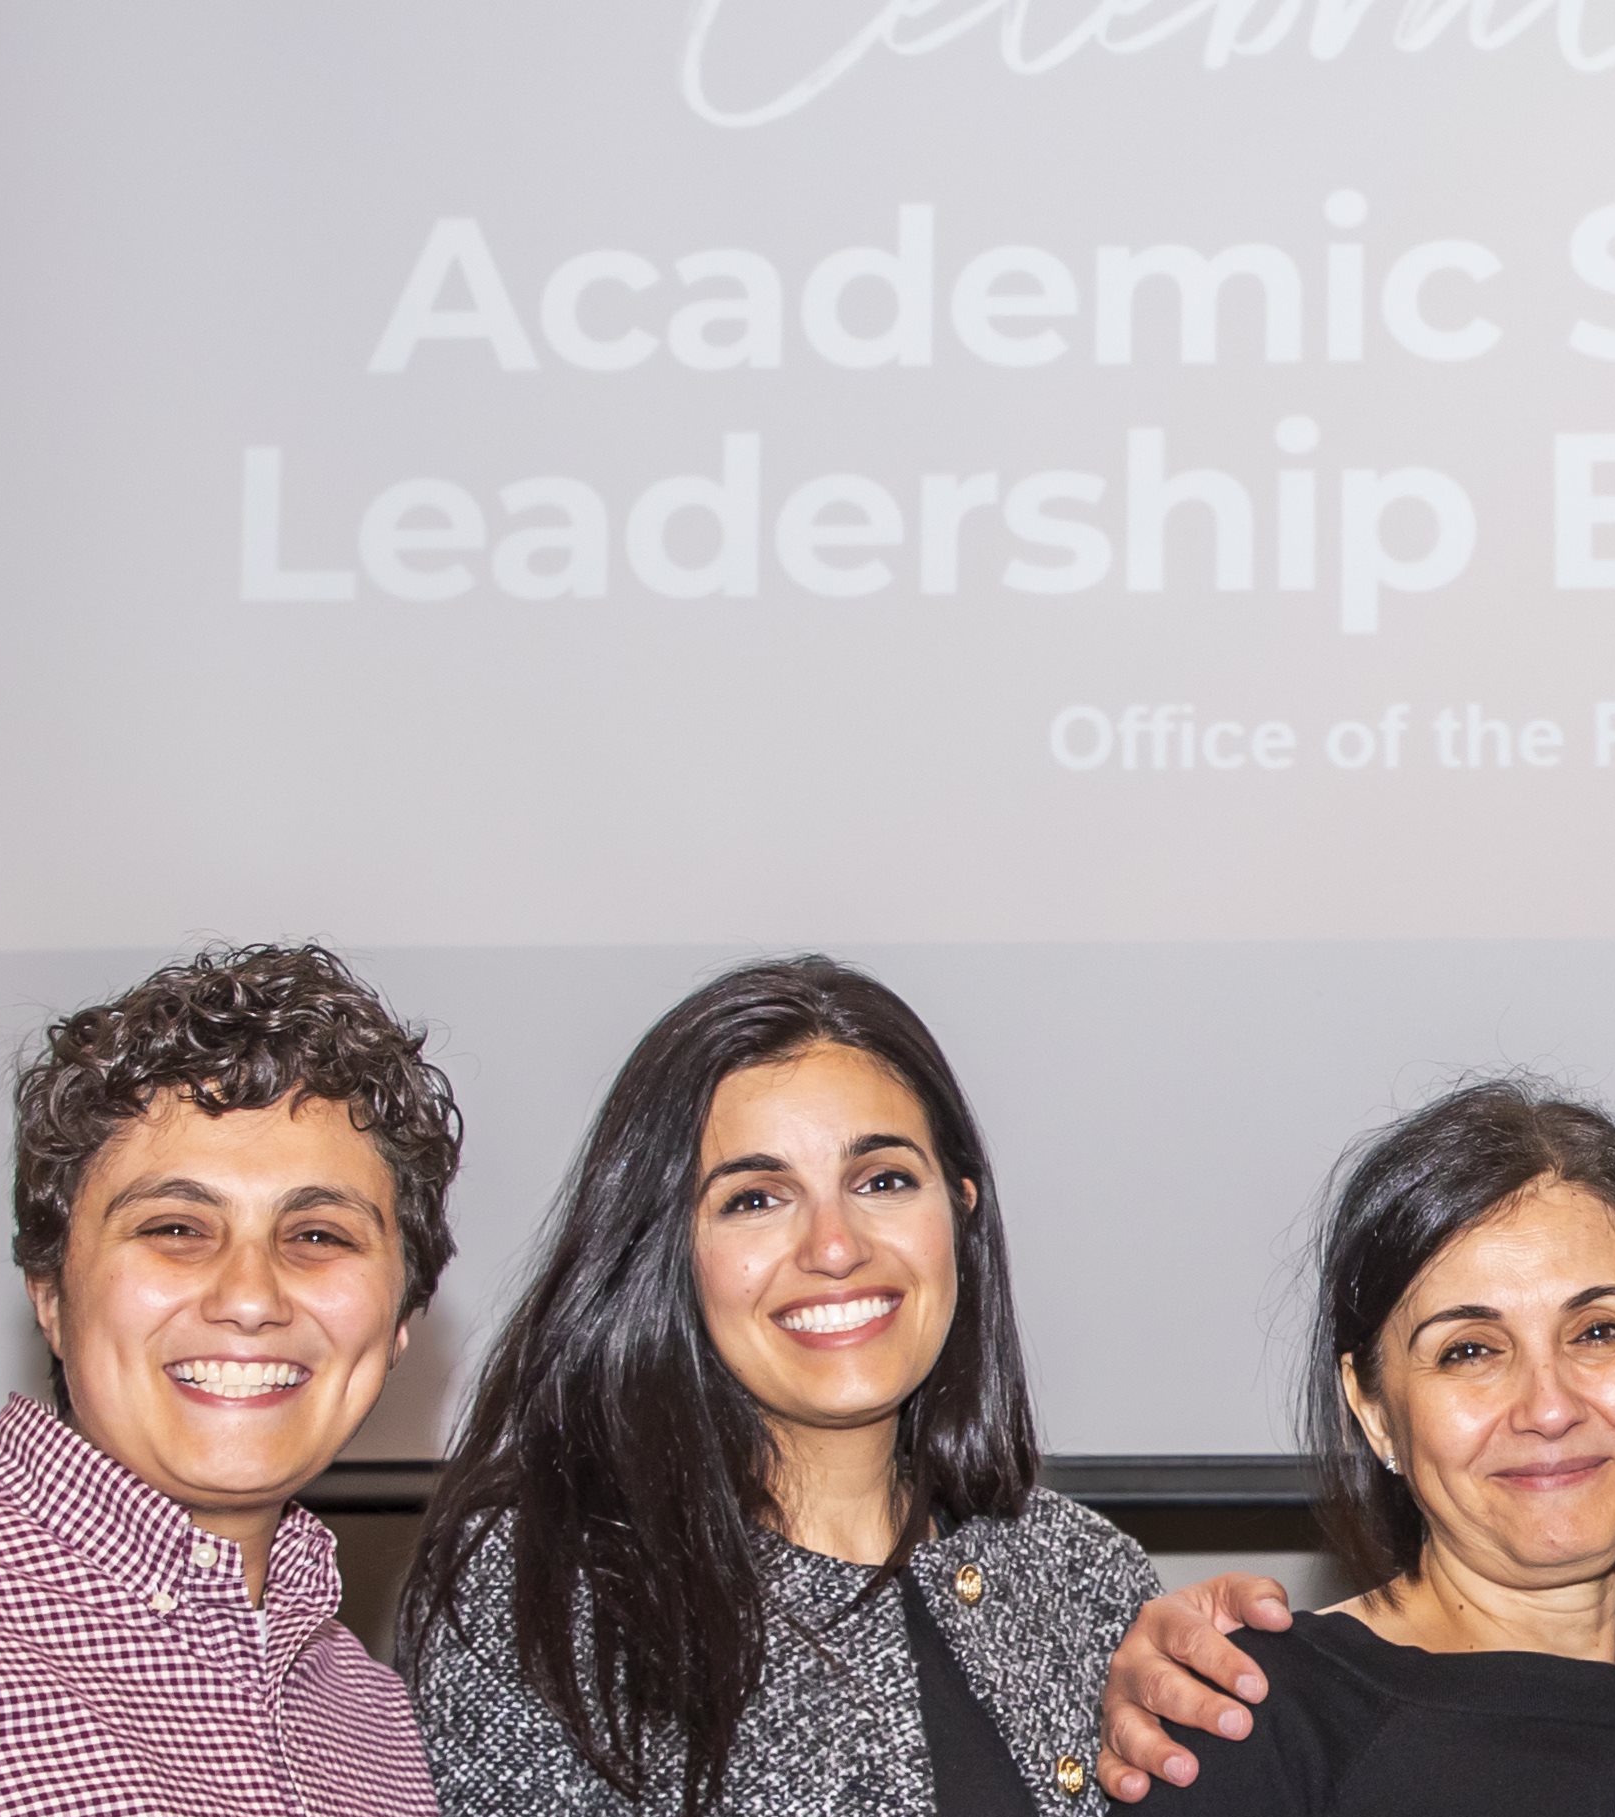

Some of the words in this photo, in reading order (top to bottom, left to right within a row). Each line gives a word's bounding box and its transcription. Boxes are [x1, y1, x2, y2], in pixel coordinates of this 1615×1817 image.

[367, 202, 1503, 374] Academic
[239, 416, 1477, 635] Leadership
[1049, 702, 1297, 771] Office
[1326, 703, 1410, 769] of
[1433, 703, 1564, 768] the
